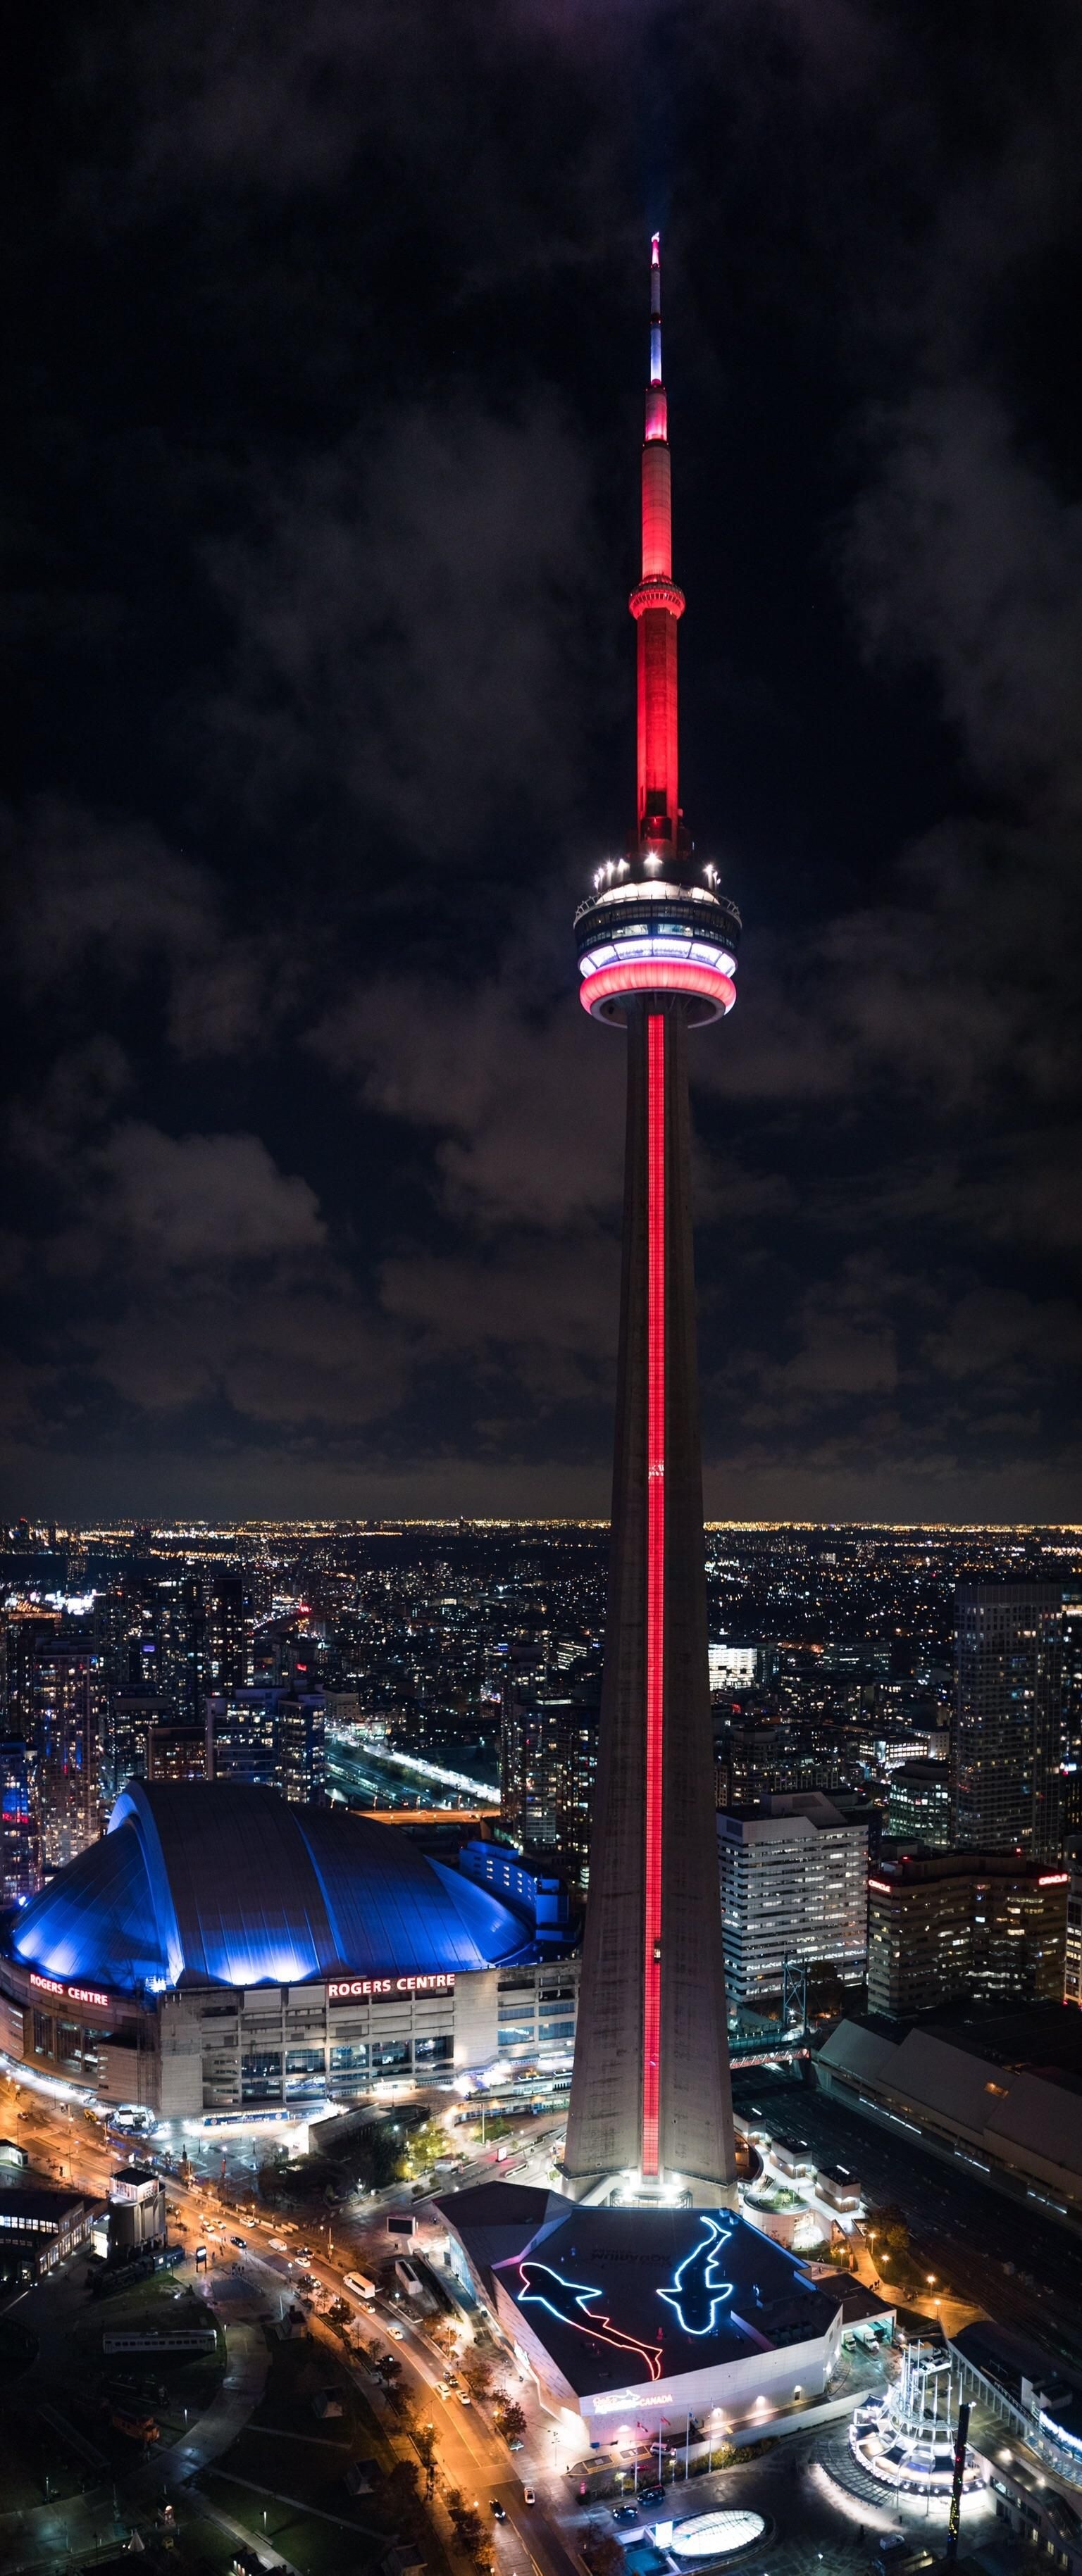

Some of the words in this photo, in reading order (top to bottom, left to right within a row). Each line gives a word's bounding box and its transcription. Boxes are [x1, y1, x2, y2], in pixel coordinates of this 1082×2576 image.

[30, 1974, 63, 1994] ROGERS
[68, 1987, 108, 2006] CENTRE
[328, 1980, 391, 1996] ROGERS
[396, 1974, 456, 1990] CENTRE
[639, 2394, 673, 2407] CANADA
